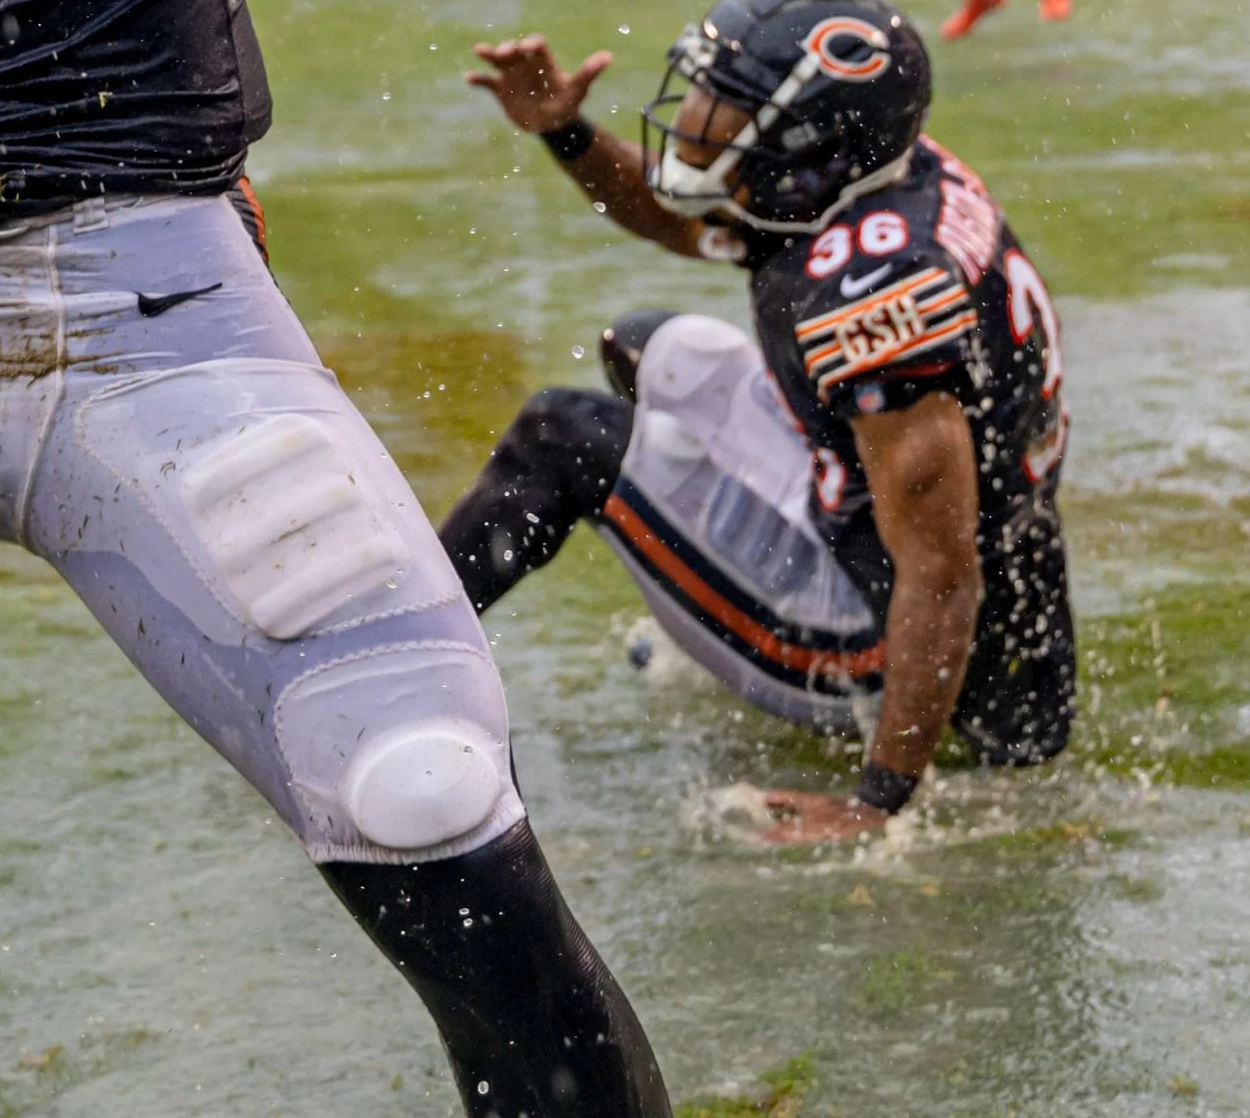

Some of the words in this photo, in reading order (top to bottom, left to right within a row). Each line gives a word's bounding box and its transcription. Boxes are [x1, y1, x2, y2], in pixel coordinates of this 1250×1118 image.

[797, 16, 892, 82] C
[805, 210, 910, 280] 36
[834, 291, 927, 366] GSH
